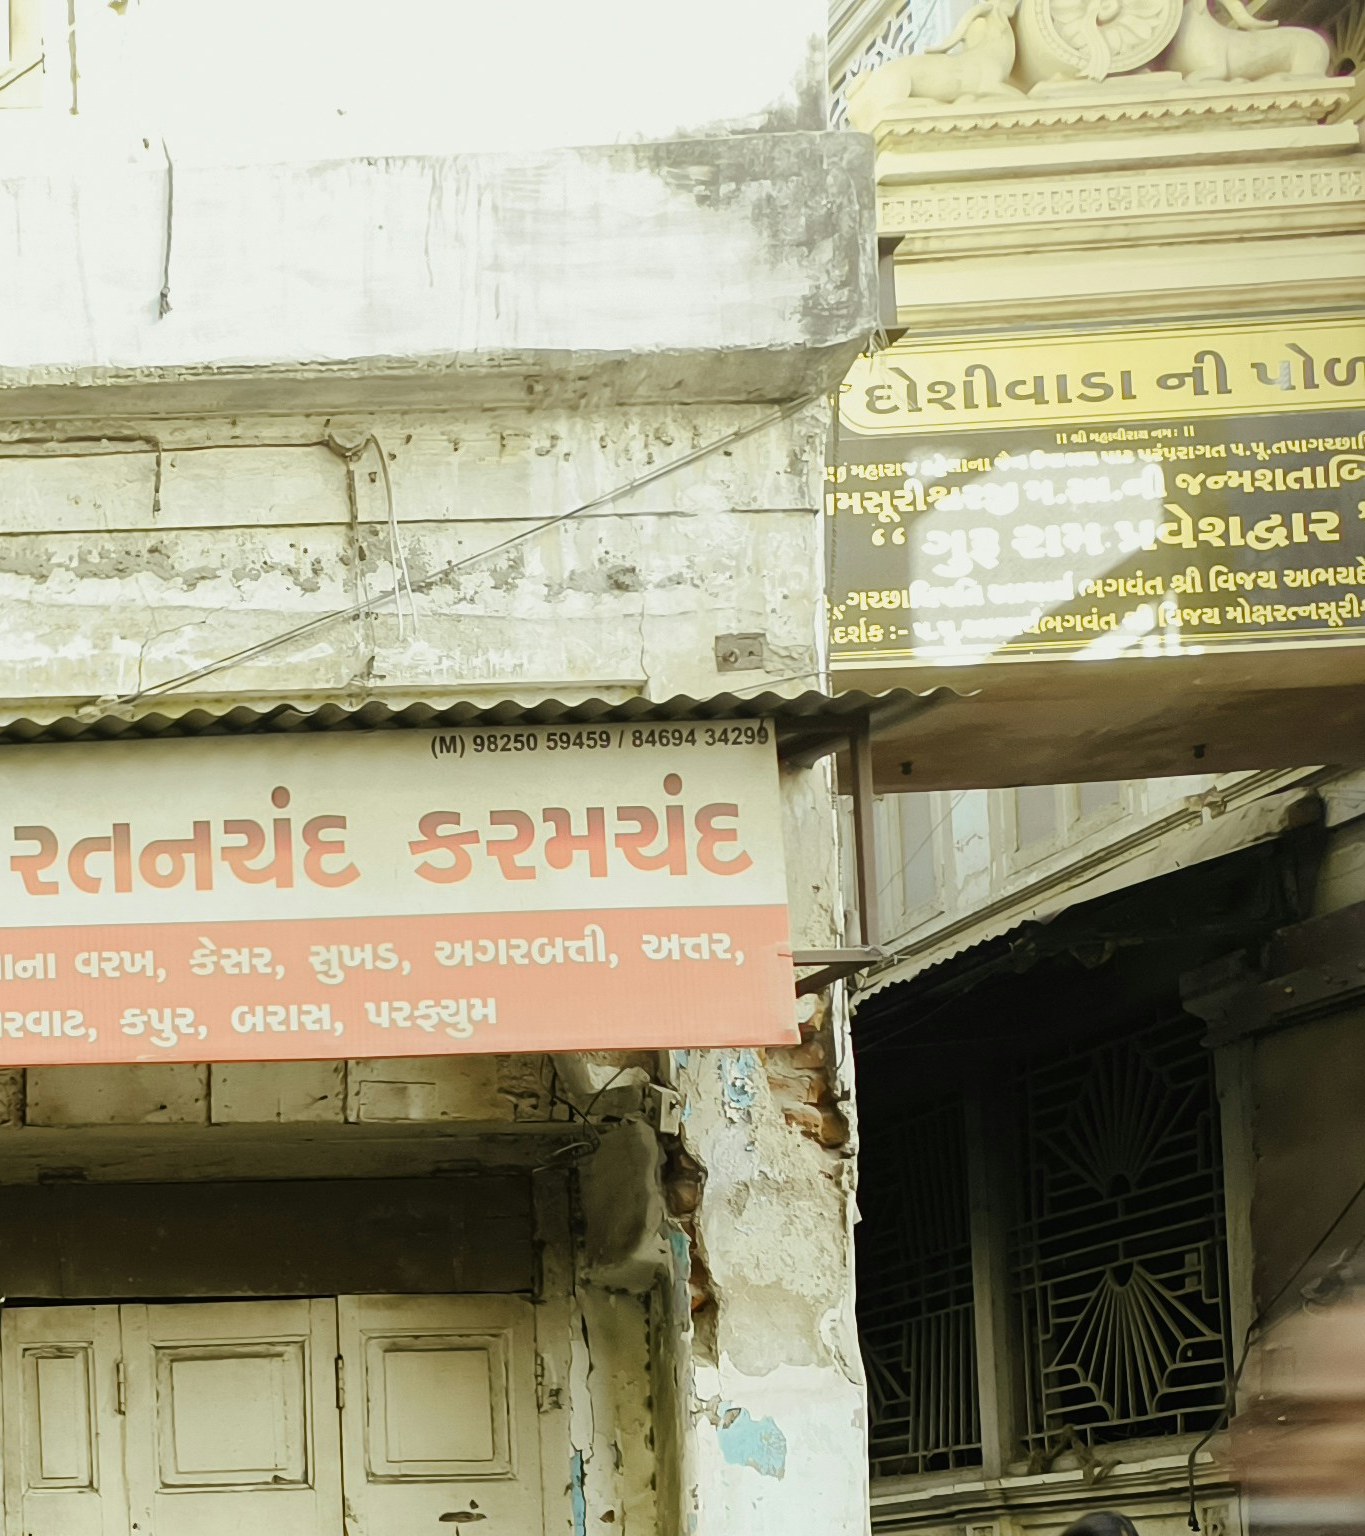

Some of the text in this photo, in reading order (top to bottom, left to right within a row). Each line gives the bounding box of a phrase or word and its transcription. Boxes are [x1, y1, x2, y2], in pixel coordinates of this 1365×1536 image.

[865, 363, 1136, 414] દોશીવાડા
[1156, 350, 1232, 395] ની
[1170, 566, 1203, 594] શ્રી
[1209, 565, 1277, 592] વિજય
[431, 734, 466, 759] (M)
[472, 733, 538, 753] 98250
[546, 731, 611, 750] 59459
[632, 728, 697, 747] 84694
[10, 785, 361, 895] રતનચંદ
[408, 772, 755, 884] કરમચંદ
[74, 950, 166, 983] વરખ,
[188, 936, 285, 980] કેસર,
[308, 942, 411, 985] સુખડ,
[434, 924, 619, 969] અગરબત્તી,
[642, 932, 744, 967] અત્તર,
[119, 1006, 207, 1048] કપુર,
[231, 1003, 344, 1037] બરાસ,
[365, 997, 497, 1039] પરફ્યુમ
